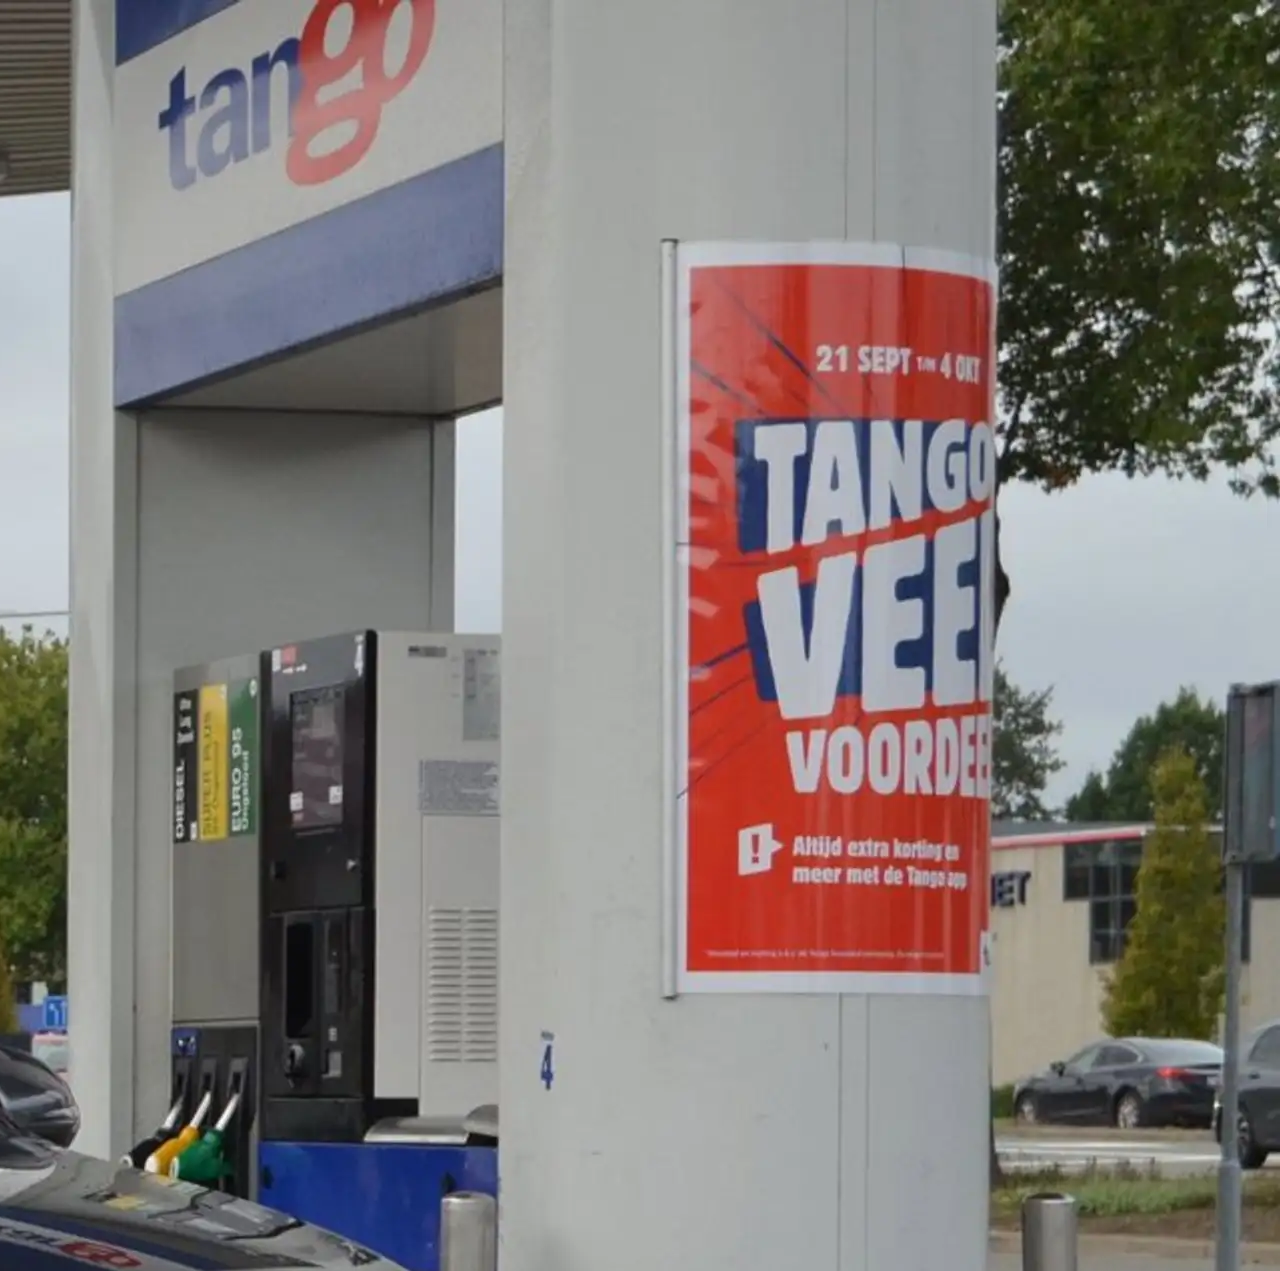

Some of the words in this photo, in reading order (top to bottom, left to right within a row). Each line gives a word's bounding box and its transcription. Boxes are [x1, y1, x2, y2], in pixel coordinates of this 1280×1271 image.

[158, 0, 436, 191] tango
[816, 345, 849, 372] 21
[858, 346, 912, 376] SEPT
[940, 352, 951, 380] 4
[955, 353, 981, 385] OKT
[754, 419, 997, 555] TANGO
[232, 727, 243, 758] 95
[786, 714, 992, 799] VOORDEE
[176, 759, 185, 839] DIESEL
[232, 768, 242, 832] EURO
[793, 836, 842, 859] Altijd
[847, 838, 889, 859] extra
[893, 838, 942, 862] korting
[793, 867, 842, 885] meer
[846, 866, 879, 885] met
[884, 865, 903, 886] de
[907, 866, 946, 889] Tango
[541, 1044, 553, 1091] 4
